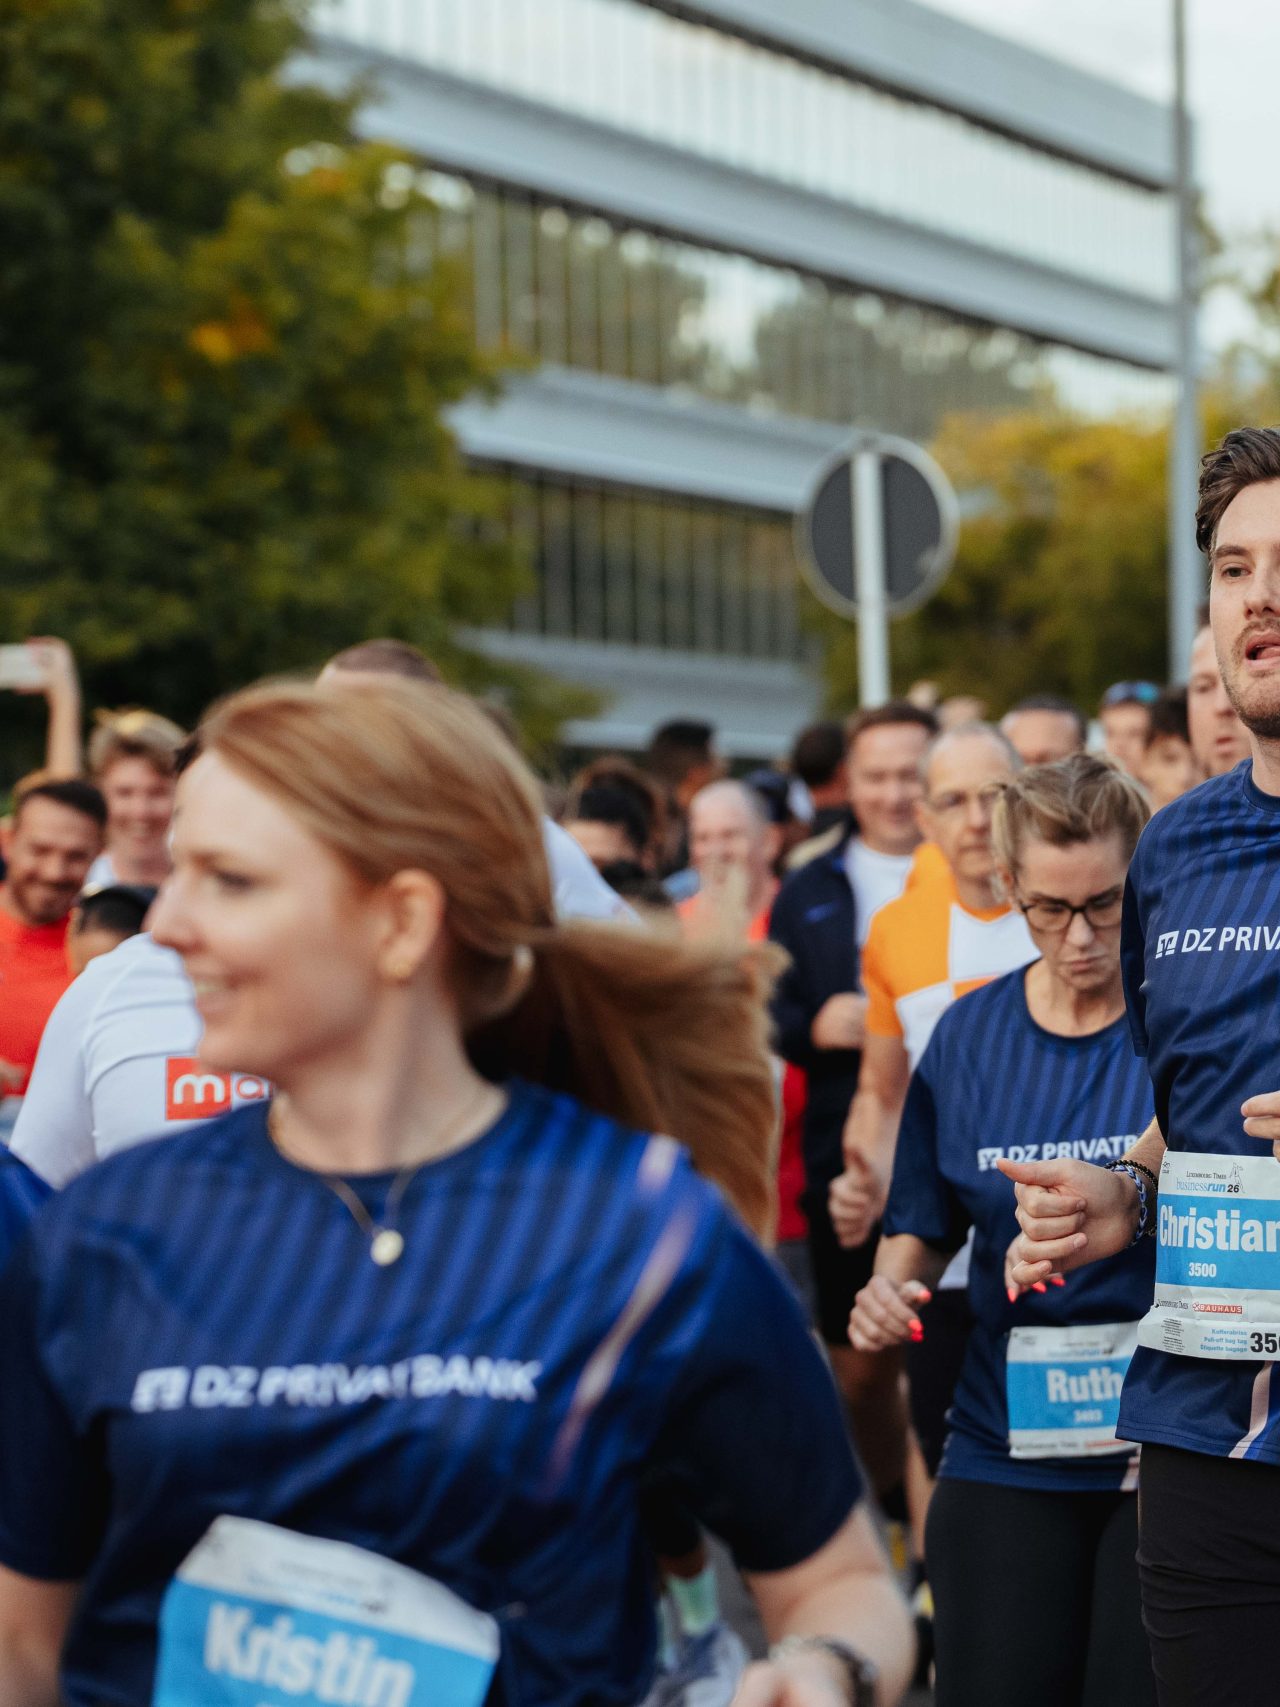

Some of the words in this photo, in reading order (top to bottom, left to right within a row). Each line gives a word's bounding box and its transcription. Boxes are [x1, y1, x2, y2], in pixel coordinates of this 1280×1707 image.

[1181, 927, 1216, 952] DZ
[173, 1074, 266, 1104] ma
[1008, 1144, 1039, 1163] DZ
[1227, 1184, 1239, 1193] 26
[1188, 1263, 1217, 1278] 3500
[1200, 1304, 1242, 1314] BAUHAUS
[191, 1364, 258, 1407] DZ
[1046, 1366, 1122, 1403] Ruth
[204, 1601, 415, 1707] Kristin
